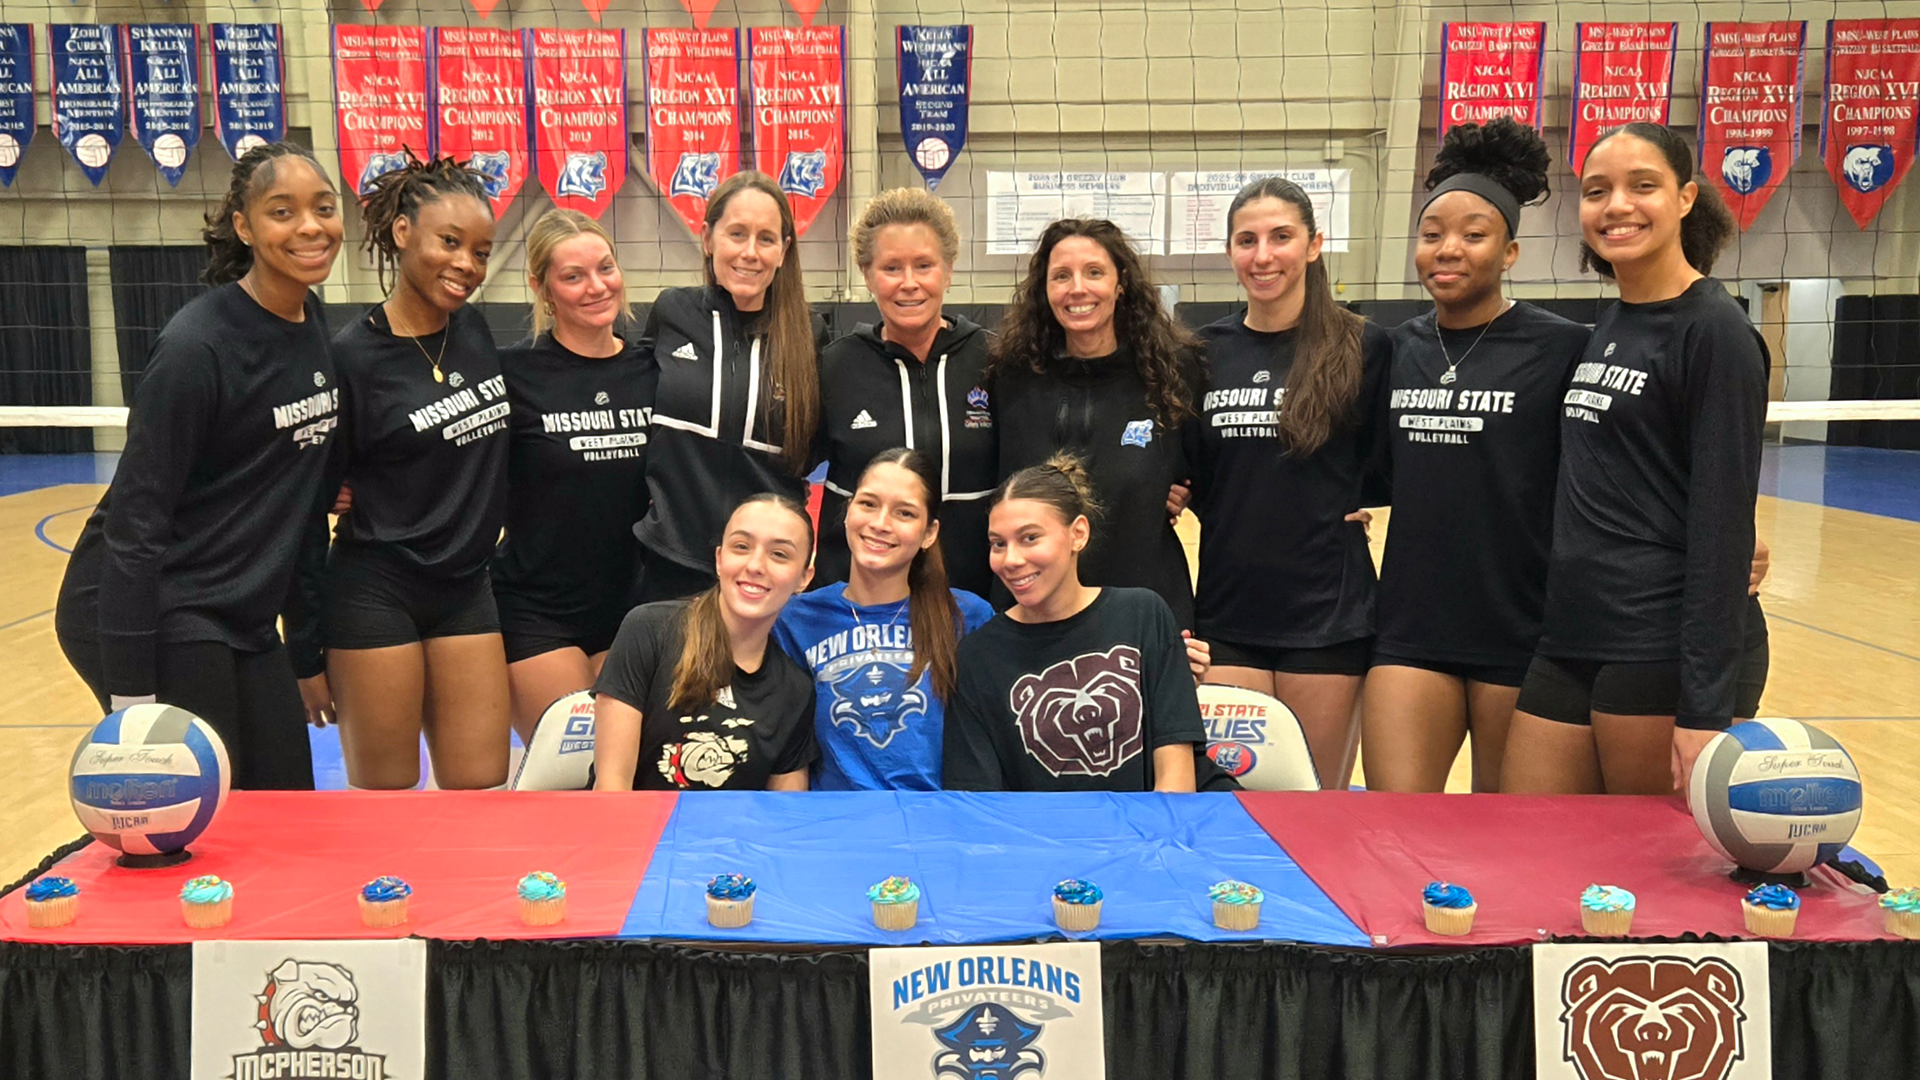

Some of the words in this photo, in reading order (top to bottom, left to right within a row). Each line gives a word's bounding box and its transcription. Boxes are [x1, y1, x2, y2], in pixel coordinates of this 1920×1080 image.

[69, 58, 105, 66] NJCAA
[1473, 65, 1511, 76] NJCAA
[75, 68, 102, 80] ALL
[152, 68, 178, 80] ALL
[237, 68, 260, 80] ALL
[463, 71, 500, 84] NJCAA
[560, 72, 597, 83] NJCAA
[676, 72, 711, 83] NJCAA
[780, 71, 815, 82] NJCAA
[922, 70, 949, 81] ALL
[1604, 65, 1643, 77] NJCAA
[1733, 71, 1772, 83] NJCAA
[1855, 69, 1894, 80] NJCAA
[56, 82, 121, 95] AMERICAN
[134, 82, 198, 96] AMERICAN
[219, 82, 280, 94] AMERICAN
[364, 75, 400, 87] NJCAA
[902, 82, 965, 96] AMERICAN
[440, 87, 489, 105] REGION
[493, 88, 523, 105] XVI
[536, 88, 586, 105] REGION
[590, 88, 621, 106] XVI
[651, 87, 700, 105] REGION
[704, 88, 735, 105] XVI
[756, 87, 805, 105] REGION
[809, 86, 840, 105] XVI
[1448, 82, 1499, 99] REGION
[1503, 82, 1533, 100] XVI
[1580, 83, 1630, 99] REGION
[1635, 82, 1668, 100] XVI
[1707, 85, 1759, 104] REGION
[1762, 85, 1795, 104] XVI
[1830, 83, 1881, 101] REGION
[1884, 82, 1919, 101] XVI
[340, 91, 393, 110] REGION
[395, 92, 425, 111] XVI
[915, 100, 953, 109] SECOND
[236, 108, 265, 118] TEAM
[444, 107, 521, 126] CHAMPIONS
[541, 108, 618, 127] CHAMPIONS
[655, 108, 732, 127] CHAMPIONS
[761, 108, 836, 126] CHAMPIONS
[920, 110, 948, 119] TEAM
[1451, 102, 1529, 121] CHAMPIONS
[1583, 103, 1662, 121] CHAMPIONS
[1710, 106, 1787, 125] CHAMPIONS
[1833, 104, 1911, 122] CHAMPIONS
[344, 113, 423, 131] CHAMPIONS
[472, 130, 494, 141] 2012
[1291, 173, 1316, 181] CLUB
[1187, 183, 1242, 192] INDIVIDUA
[1601, 365, 1649, 395] STATE
[1390, 388, 1454, 410] MISSOURI
[1457, 389, 1516, 414] STATE
[273, 391, 332, 430] MISSOURI
[407, 388, 480, 432] MISSOURI
[1219, 413, 1247, 423] WEST
[1252, 413, 1279, 423] PLA
[451, 420, 475, 435] WEST
[479, 404, 508, 424] PLAINS
[541, 409, 615, 433] MISSOURI
[619, 407, 653, 428] STAT
[1407, 417, 1434, 427] WEST
[1438, 418, 1473, 429] PLAINS
[580, 437, 605, 447] WEST
[609, 435, 640, 445] PLAINS
[1221, 427, 1278, 438] VOLLEYBAL
[1408, 431, 1469, 444] VOLLEYBALL
[583, 448, 639, 461] VOLLEYBALL
[805, 630, 848, 668] NEW
[852, 624, 913, 651] ORLE
[829, 653, 914, 672] PRIVATEER
[1213, 704, 1268, 717] STATE
[89, 750, 124, 768] Super
[1758, 756, 1802, 773] Super
[86, 779, 178, 800] molten
[1760, 783, 1852, 807] molten
[893, 960, 952, 1012] NEW
[957, 956, 1081, 1004] ORLEANS
[928, 991, 1049, 1015] PRIVATEERS
[235, 1051, 382, 1080] MCPHERSON
